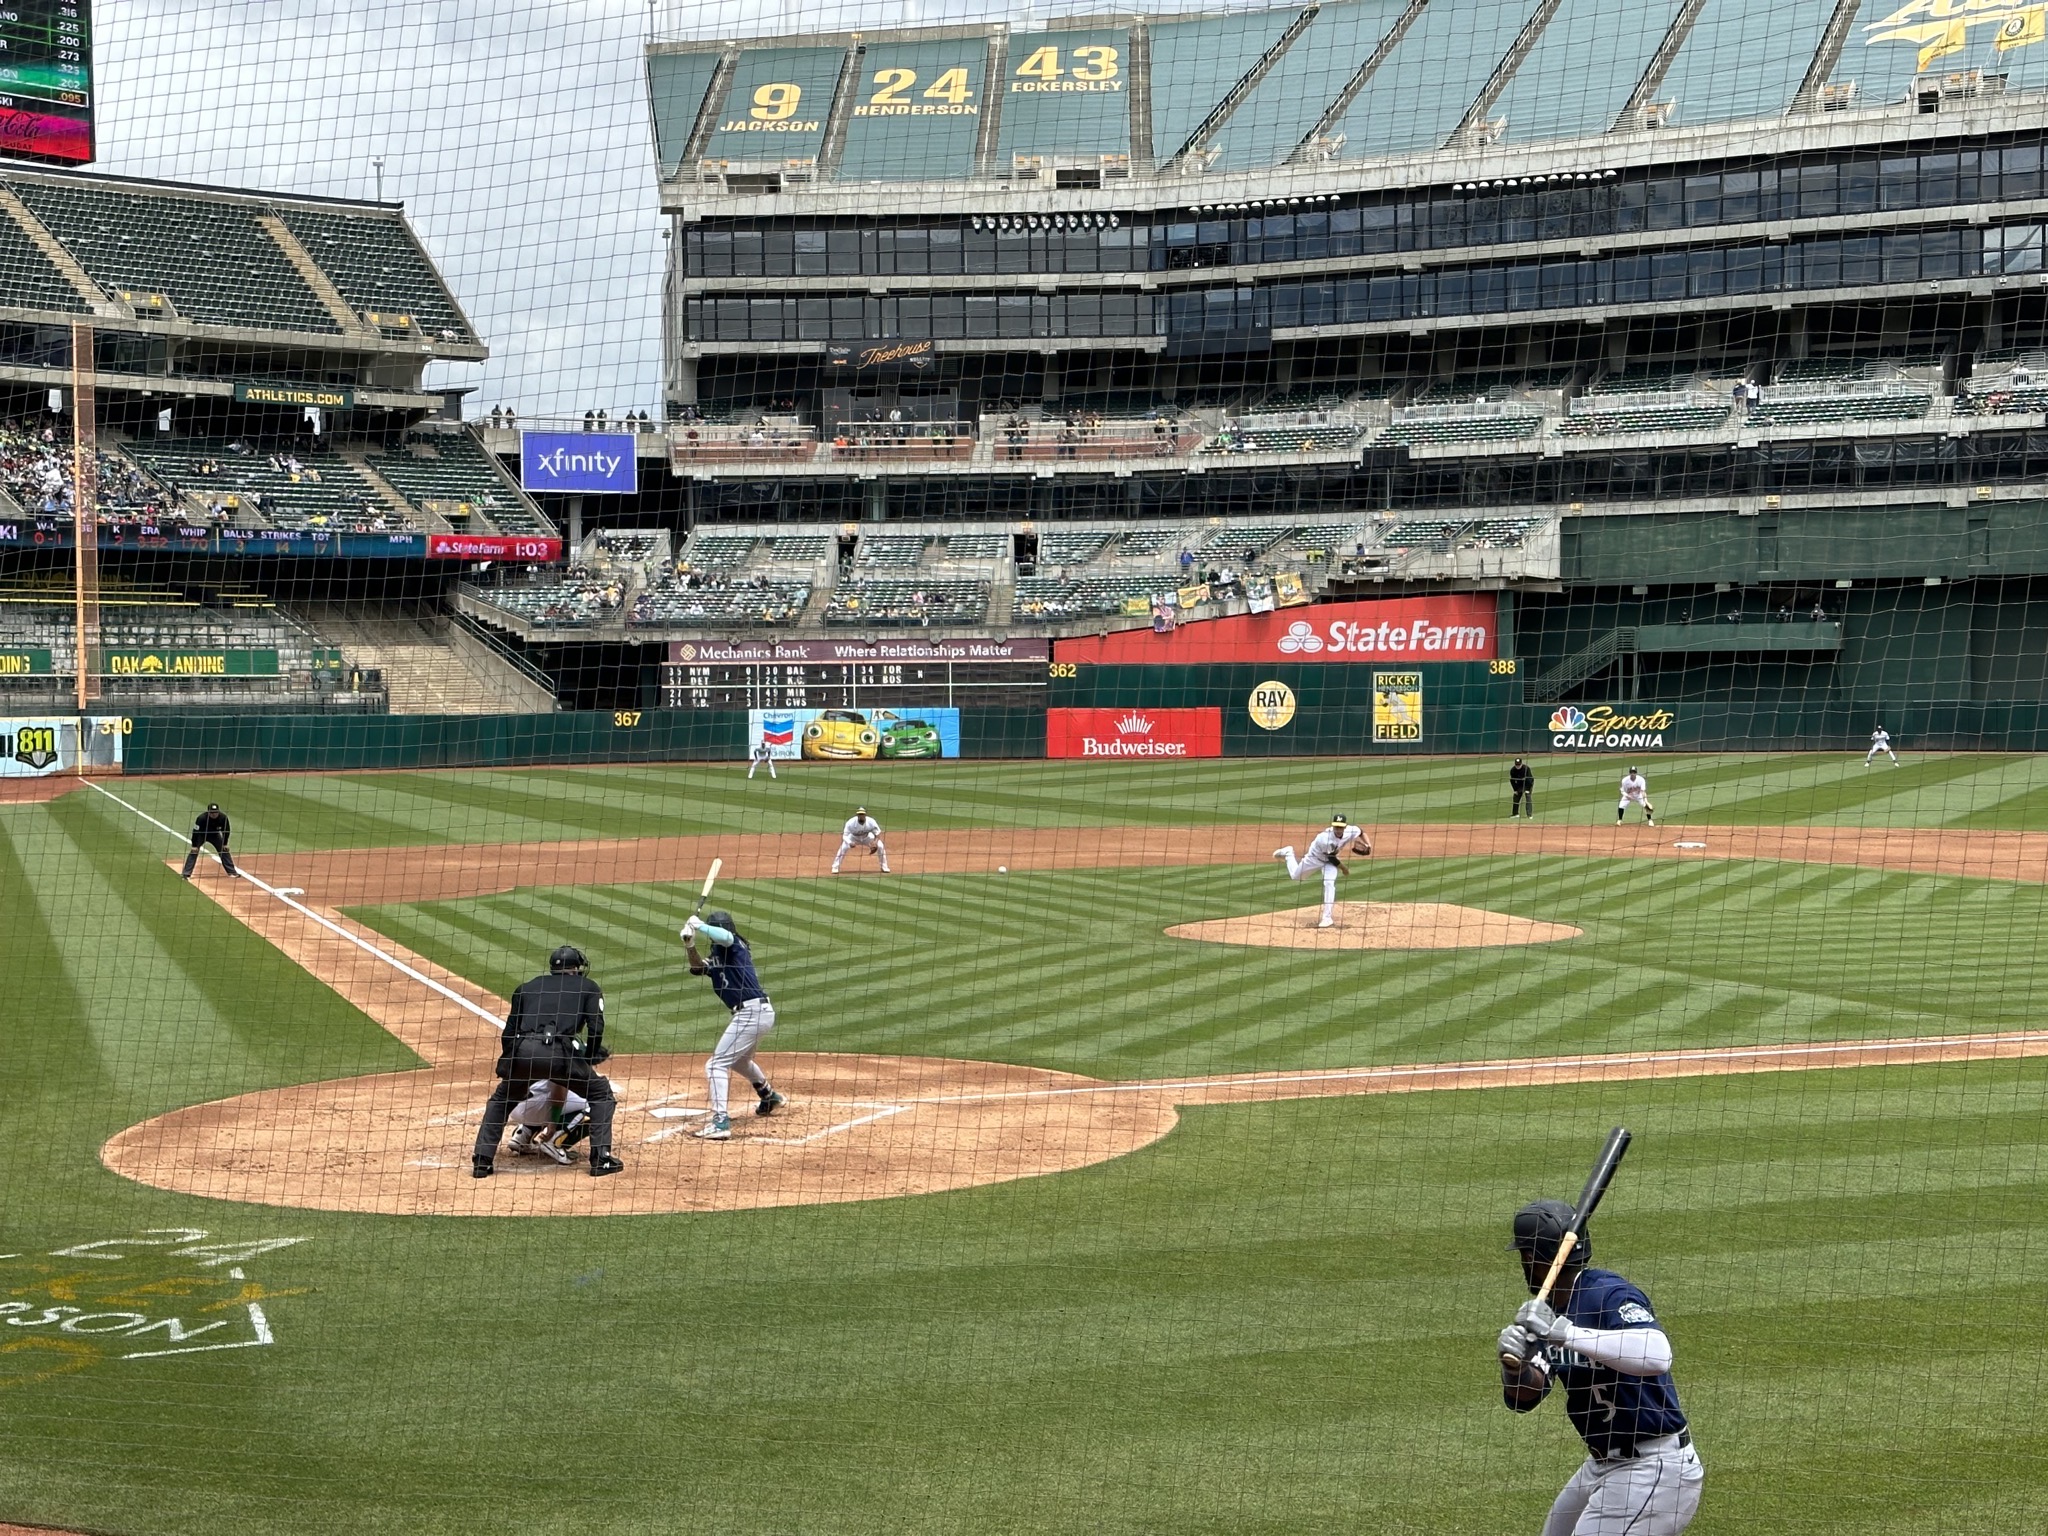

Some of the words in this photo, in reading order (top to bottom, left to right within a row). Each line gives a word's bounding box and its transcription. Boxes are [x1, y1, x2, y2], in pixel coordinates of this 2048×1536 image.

[57, 22, 79, 33] .225
[57, 36, 80, 47] .200
[58, 50, 80, 61] .273
[1016, 46, 1119, 80] 43
[58, 78, 80, 89] .202
[870, 68, 973, 104] 24
[1011, 80, 1122, 93] ECKERSLEY
[59, 92, 81, 103] .095
[751, 84, 801, 120] 9
[854, 105, 978, 116] HENDERSON
[720, 121, 819, 132] JACKSON
[856, 341, 931, 370] Treehouse
[246, 389, 344, 405] ATHLETICS.COM
[538, 448, 621, 478] xfinity
[113, 525, 120, 533] K
[141, 526, 160, 535] ERA
[180, 528, 206, 537] WHIP
[223, 530, 254, 539] BALLS
[261, 531, 302, 540] STRIKES
[311, 533, 330, 541] TOT
[389, 535, 412, 544] MPH
[114, 535, 123, 545] 2
[516, 543, 548, 557] 1:03
[700, 645, 771, 659] Mechanics
[775, 645, 808, 658] Bank
[835, 645, 877, 657] Where
[881, 645, 965, 660] Relationships
[970, 645, 1013, 657] Matter
[112, 656, 140, 674] OAK
[165, 656, 225, 673] LANDING
[689, 667, 710, 676] NYM
[882, 665, 902, 674] TOR
[1049, 663, 1077, 678] 362
[1489, 660, 1516, 674] 388
[787, 666, 805, 675] BAL
[821, 671, 827, 679] 6
[842, 666, 847, 675] 8
[690, 677, 709, 685] DET
[746, 677, 751, 685] 2
[843, 676, 847, 685] 7
[882, 675, 902, 684] BOS
[1378, 676, 1417, 685] RICKEY
[692, 689, 708, 697] PIT
[746, 689, 751, 697] 2
[787, 688, 805, 696] MIN
[843, 688, 847, 696] 1
[746, 698, 751, 707] 3
[786, 698, 807, 707] CWS
[842, 697, 847, 706] 2
[1257, 691, 1287, 707] RAY
[614, 712, 641, 726] 367
[1587, 706, 1674, 736] Sports
[101, 719, 132, 735] 30
[1378, 725, 1418, 738] FIELD
[19, 728, 53, 753] 811
[1082, 737, 1185, 755] Budweiser
[1553, 734, 1663, 747] CALIFORNIA
[1592, 1385, 1616, 1422] 5
